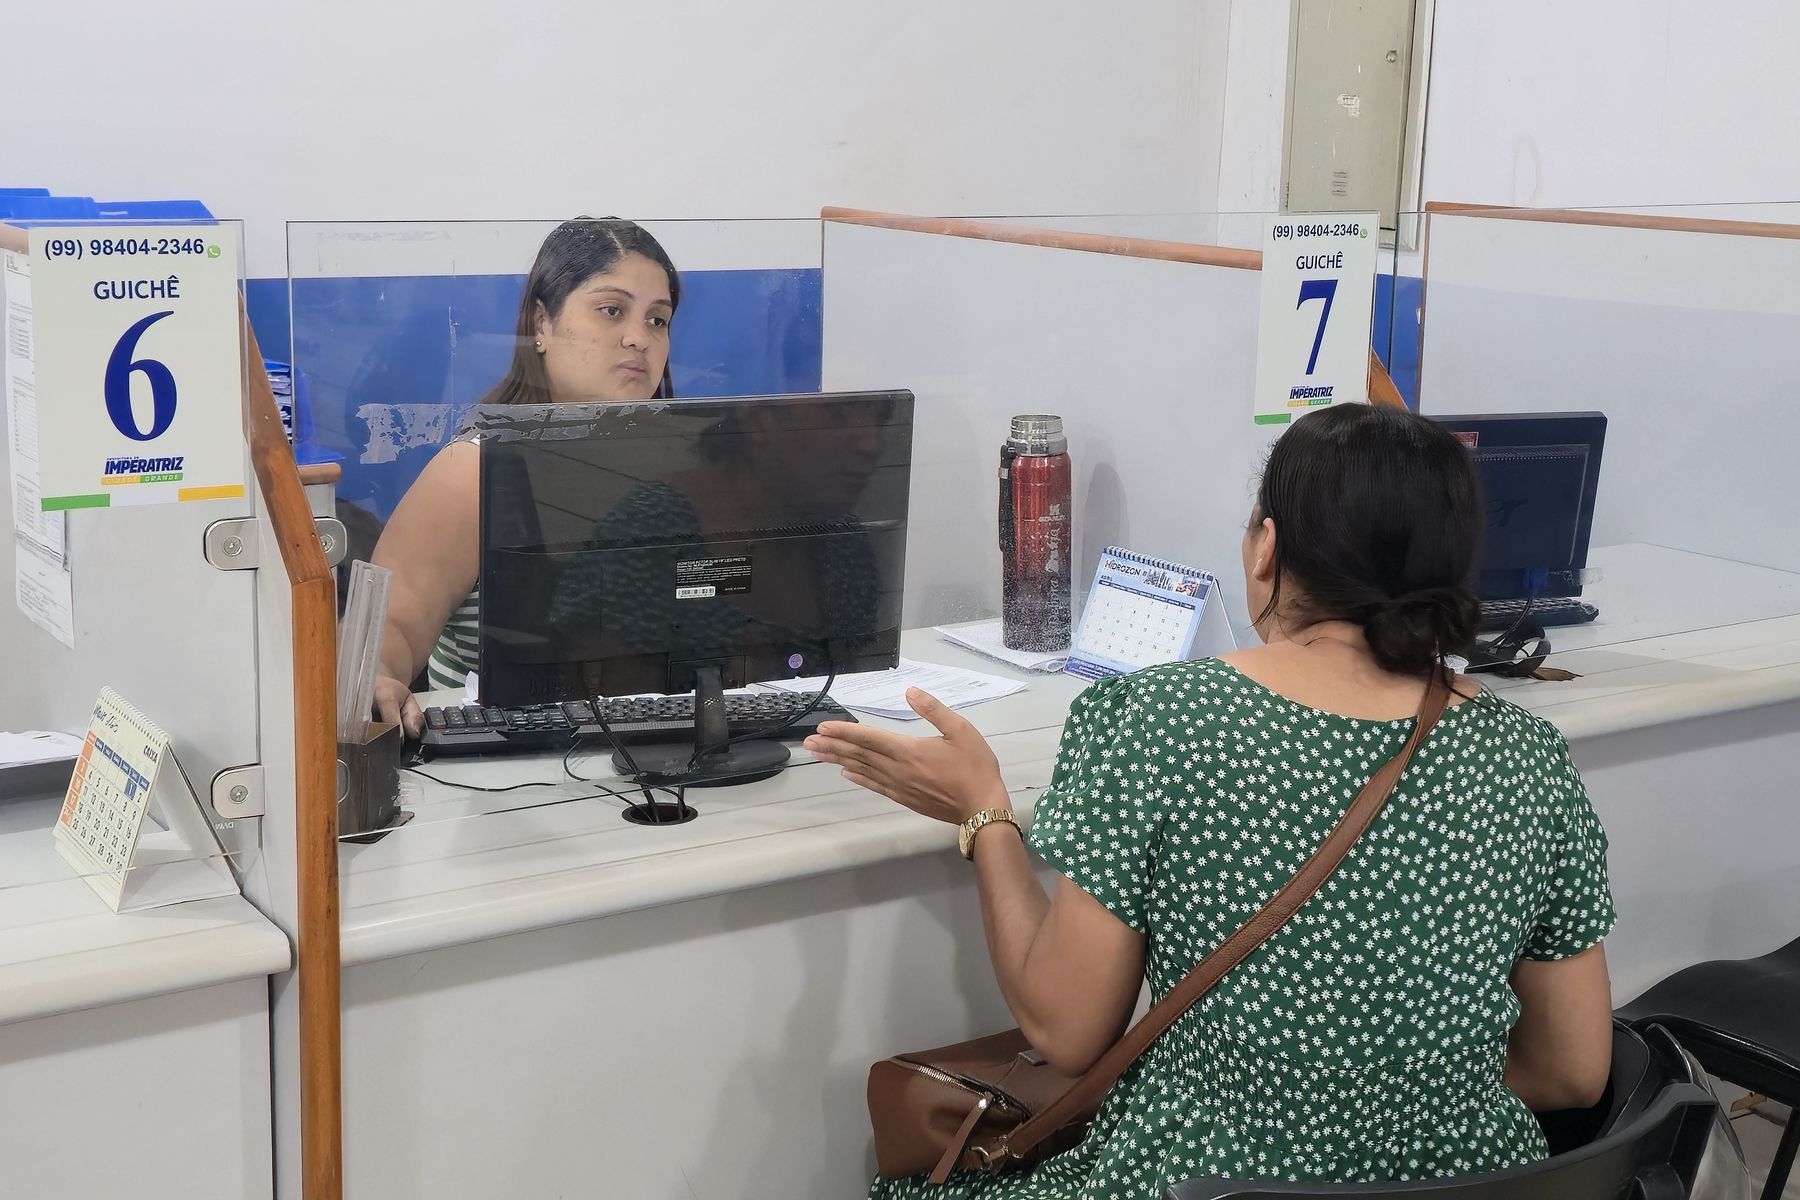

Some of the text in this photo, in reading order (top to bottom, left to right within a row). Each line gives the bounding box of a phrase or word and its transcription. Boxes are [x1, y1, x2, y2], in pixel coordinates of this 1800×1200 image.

[1272, 223, 1359, 240] (99) 98404-2346
[44, 238, 204, 260] (99) 98404-2346
[1296, 251, 1343, 270] GUICHÊ
[93, 275, 180, 300] GUICHÊ
[1296, 279, 1339, 376] 7
[104, 310, 178, 441] 6
[1289, 386, 1334, 400] IMPERATRIZ
[104, 456, 184, 475] IMPERATRIZ
[113, 793, 119, 803] 7
